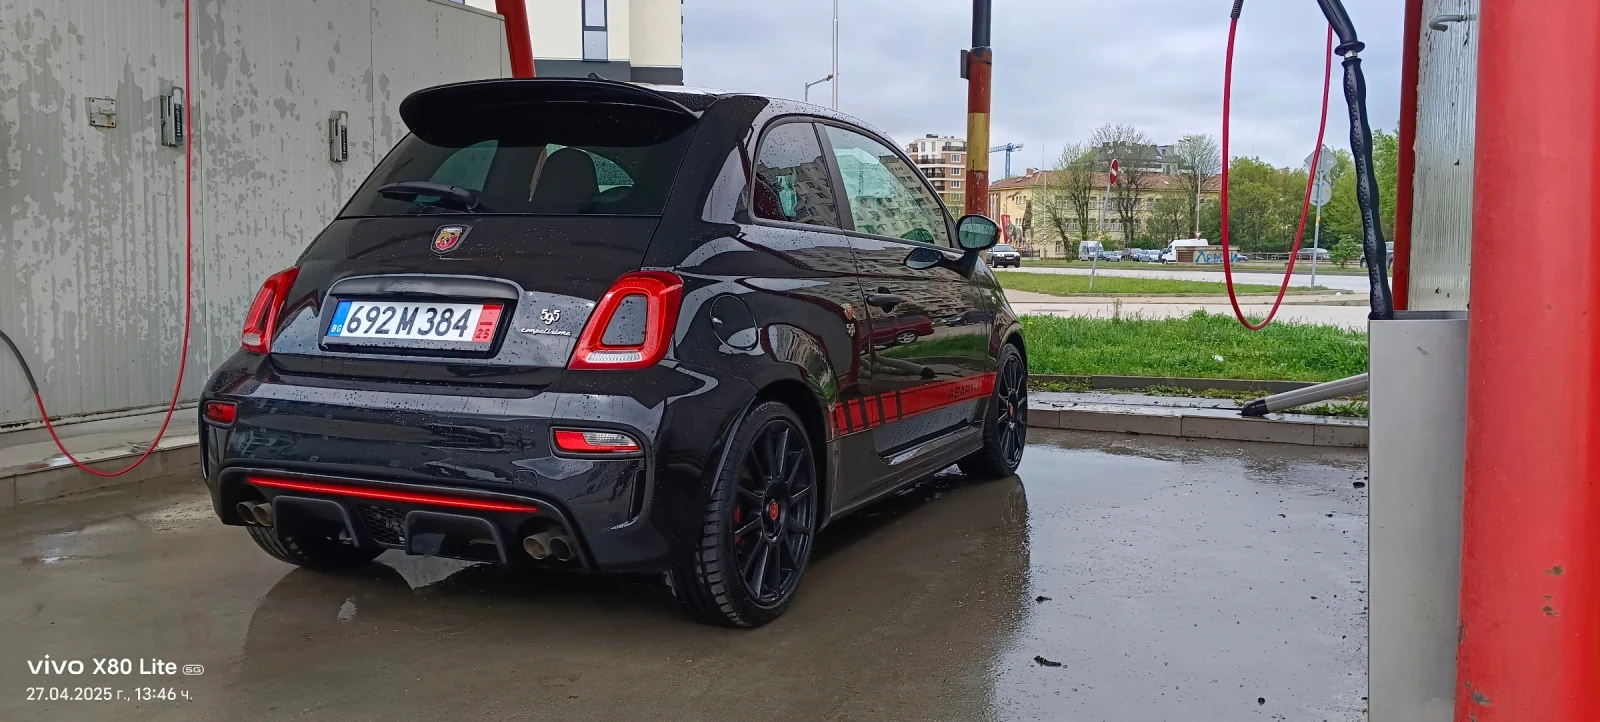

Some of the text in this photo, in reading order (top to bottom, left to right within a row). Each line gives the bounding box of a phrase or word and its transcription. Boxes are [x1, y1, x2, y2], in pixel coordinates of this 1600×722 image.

[1195, 250, 1238, 264] ЛЕВСИ
[540, 308, 560, 325] 595
[330, 324, 342, 333] BG
[475, 328, 490, 340] 25
[520, 327, 572, 336] competizione
[949, 382, 979, 398] ABARTH
